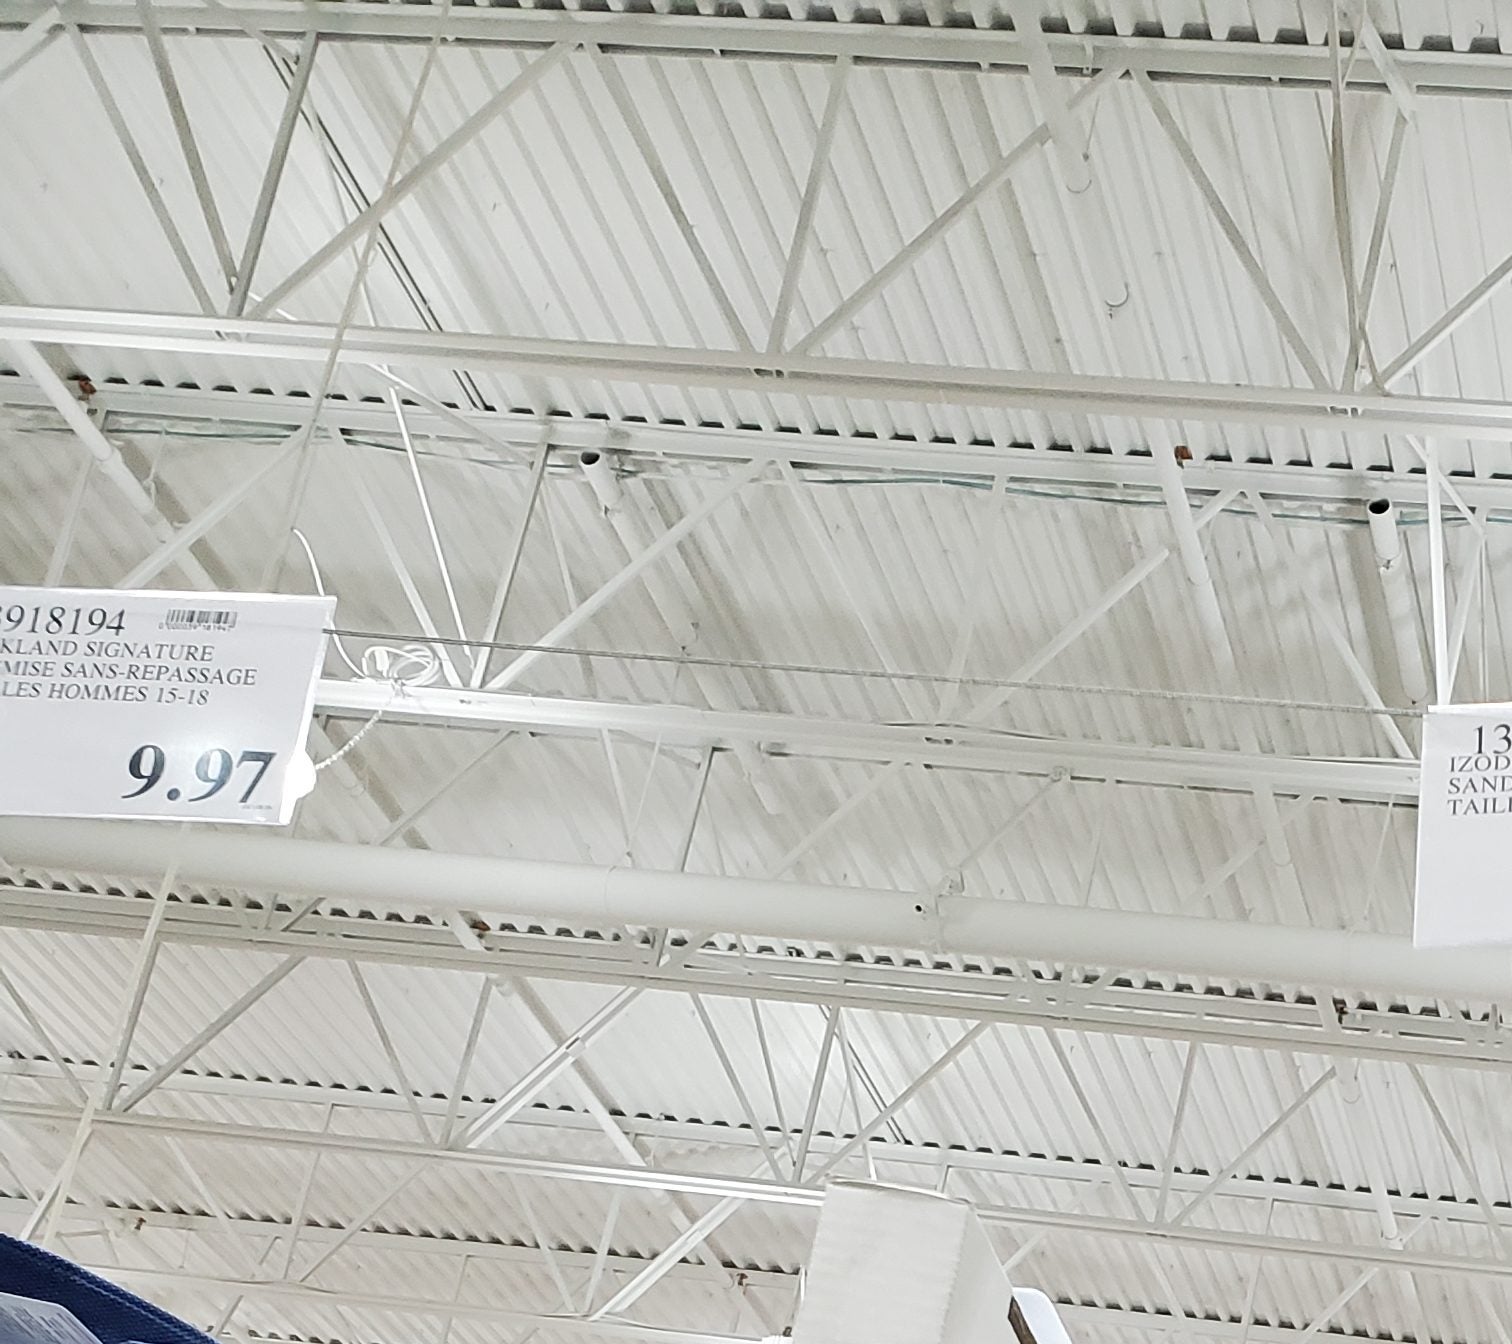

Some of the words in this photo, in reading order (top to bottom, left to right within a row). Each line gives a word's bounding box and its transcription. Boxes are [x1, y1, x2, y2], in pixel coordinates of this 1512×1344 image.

[0, 604, 126, 637] 918194
[84, 640, 216, 662] SIGNATURE
[60, 661, 258, 686] SANS-REPASSAGE
[48, 683, 149, 703] HOMMES
[156, 687, 210, 706] 15-18
[120, 744, 278, 804] 9.97
[1449, 754, 1511, 773] IZOD
